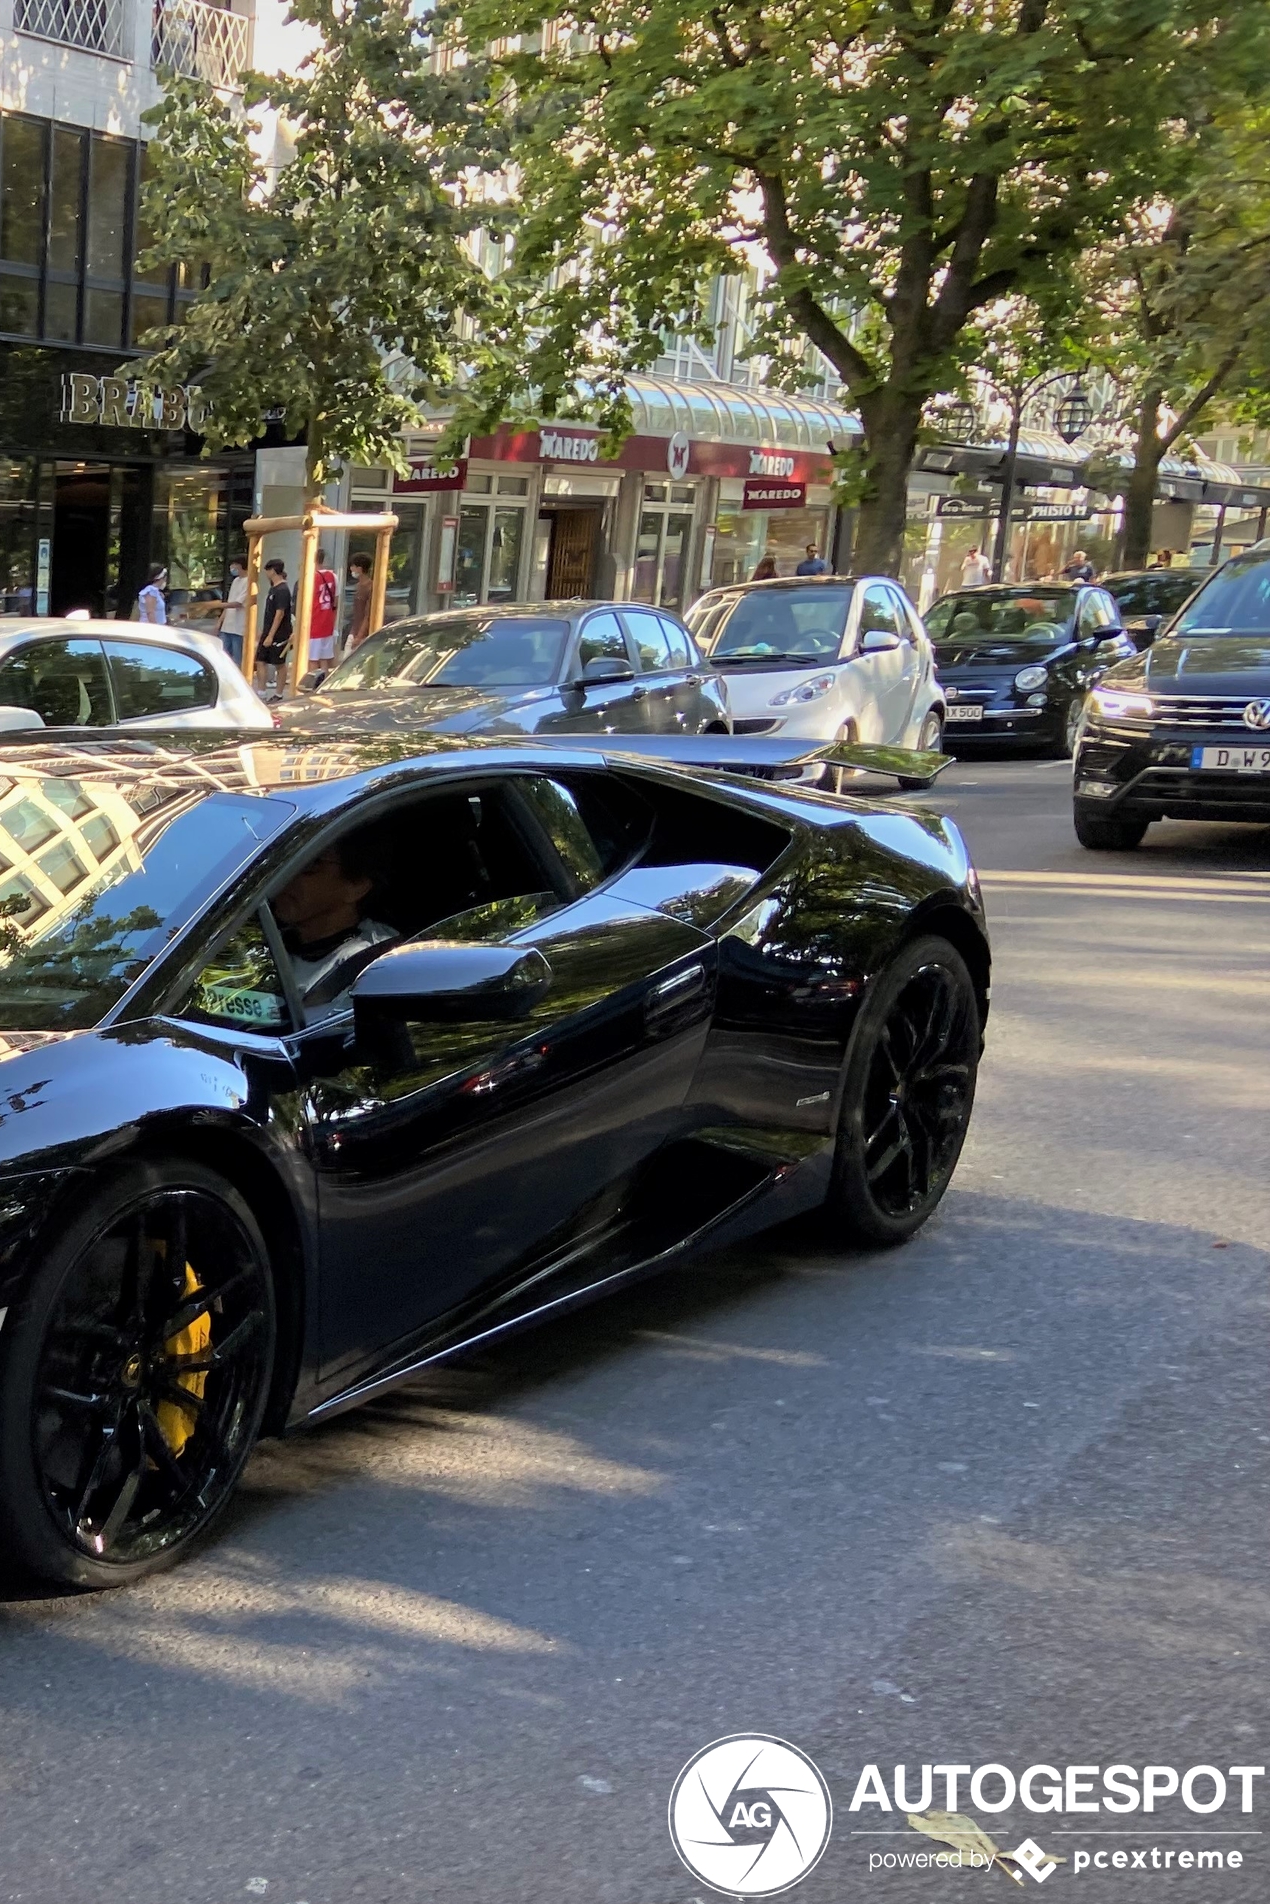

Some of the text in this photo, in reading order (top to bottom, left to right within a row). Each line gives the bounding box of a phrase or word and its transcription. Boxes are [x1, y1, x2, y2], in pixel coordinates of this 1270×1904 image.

[70, 373, 214, 434] BRABU
[539, 430, 598, 462] MAREDO
[749, 450, 794, 477] MAREDO
[400, 466, 460, 481] AREDO
[747, 488, 802, 501] MAREDO
[1031, 505, 1073, 517] PHISTO
[959, 707, 981, 717] 500
[1217, 750, 1229, 767] D
